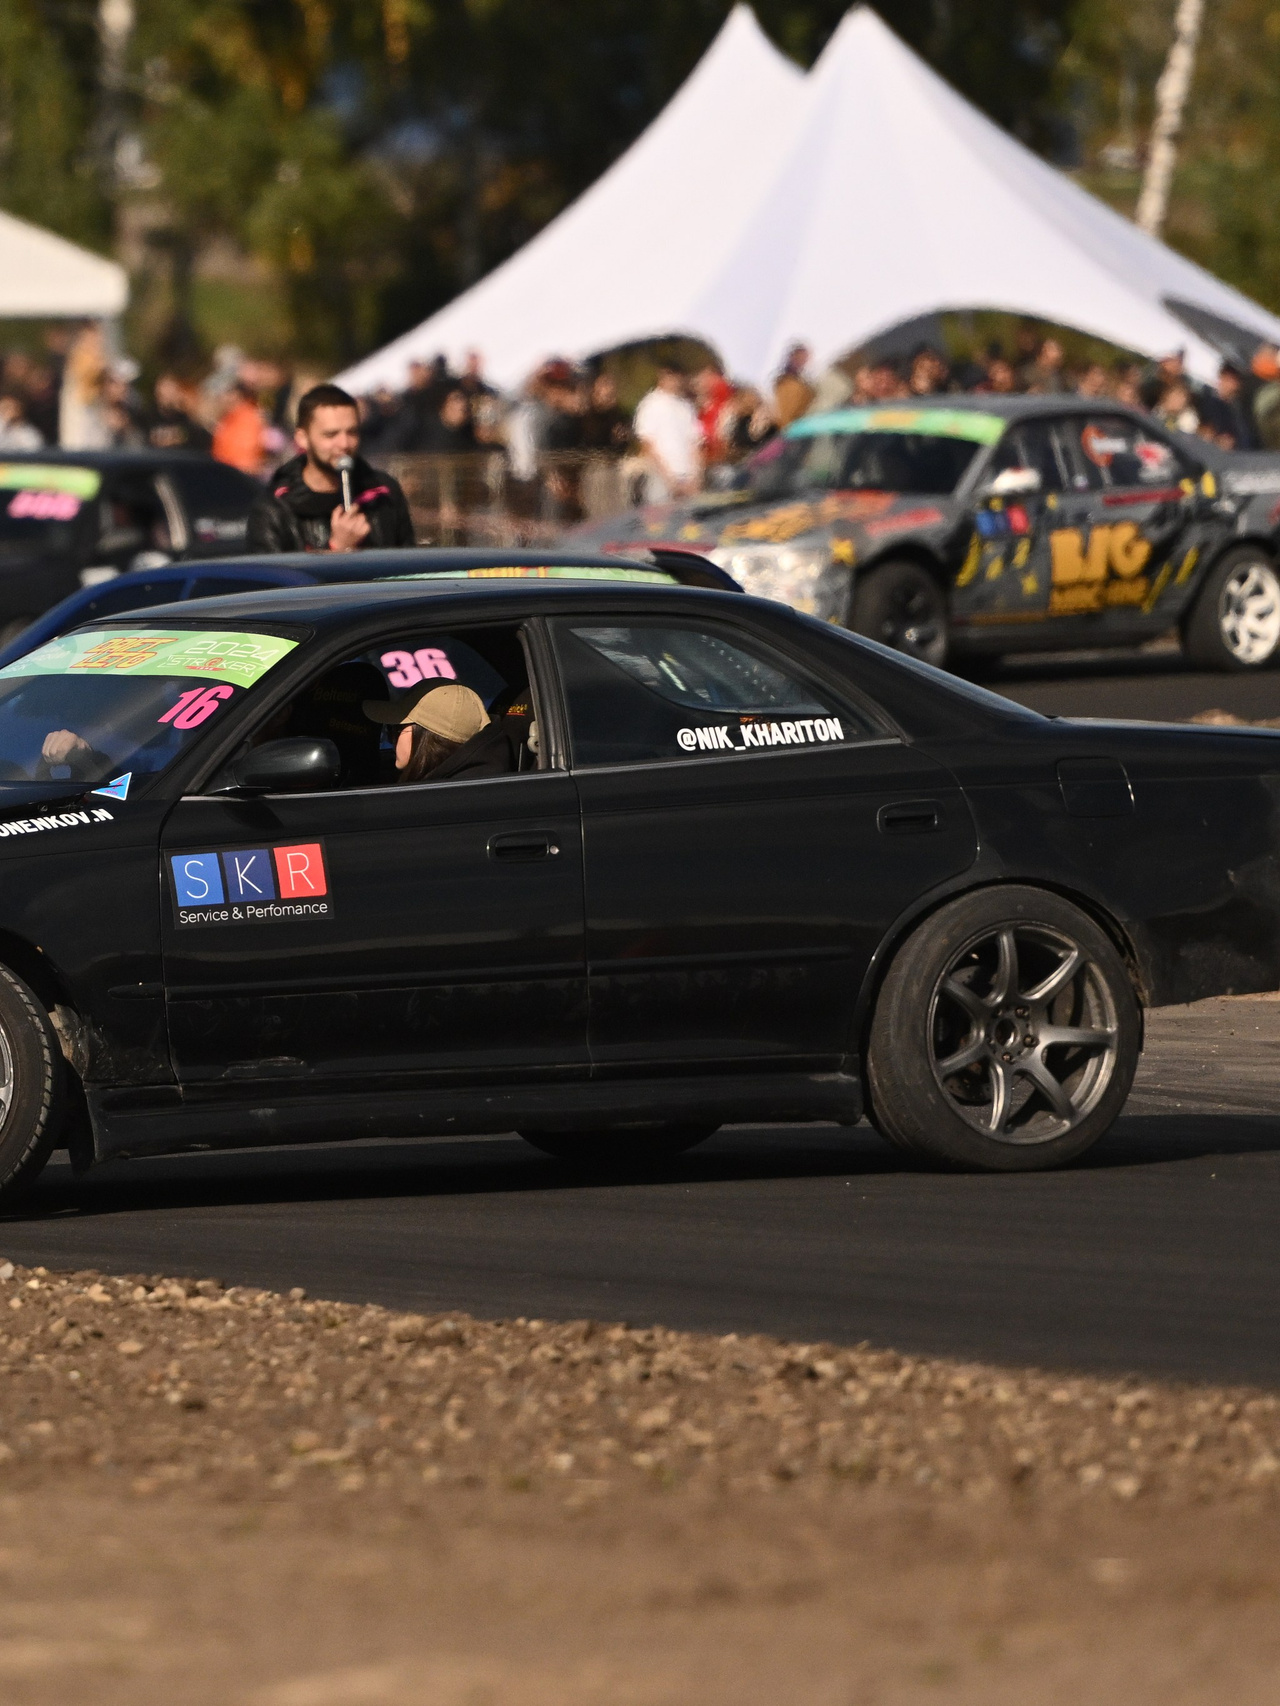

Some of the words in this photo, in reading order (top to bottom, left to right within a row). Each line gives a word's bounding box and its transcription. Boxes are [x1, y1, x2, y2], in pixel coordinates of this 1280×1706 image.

[184, 640, 279, 661] 2024
[380, 648, 457, 688] 36
[157, 685, 234, 729] 16
[676, 717, 844, 751] @NIK_KHARITON
[184, 852, 315, 899] SKR
[179, 909, 229, 924] Service
[232, 907, 244, 920] &
[246, 902, 328, 919] Perfomance
